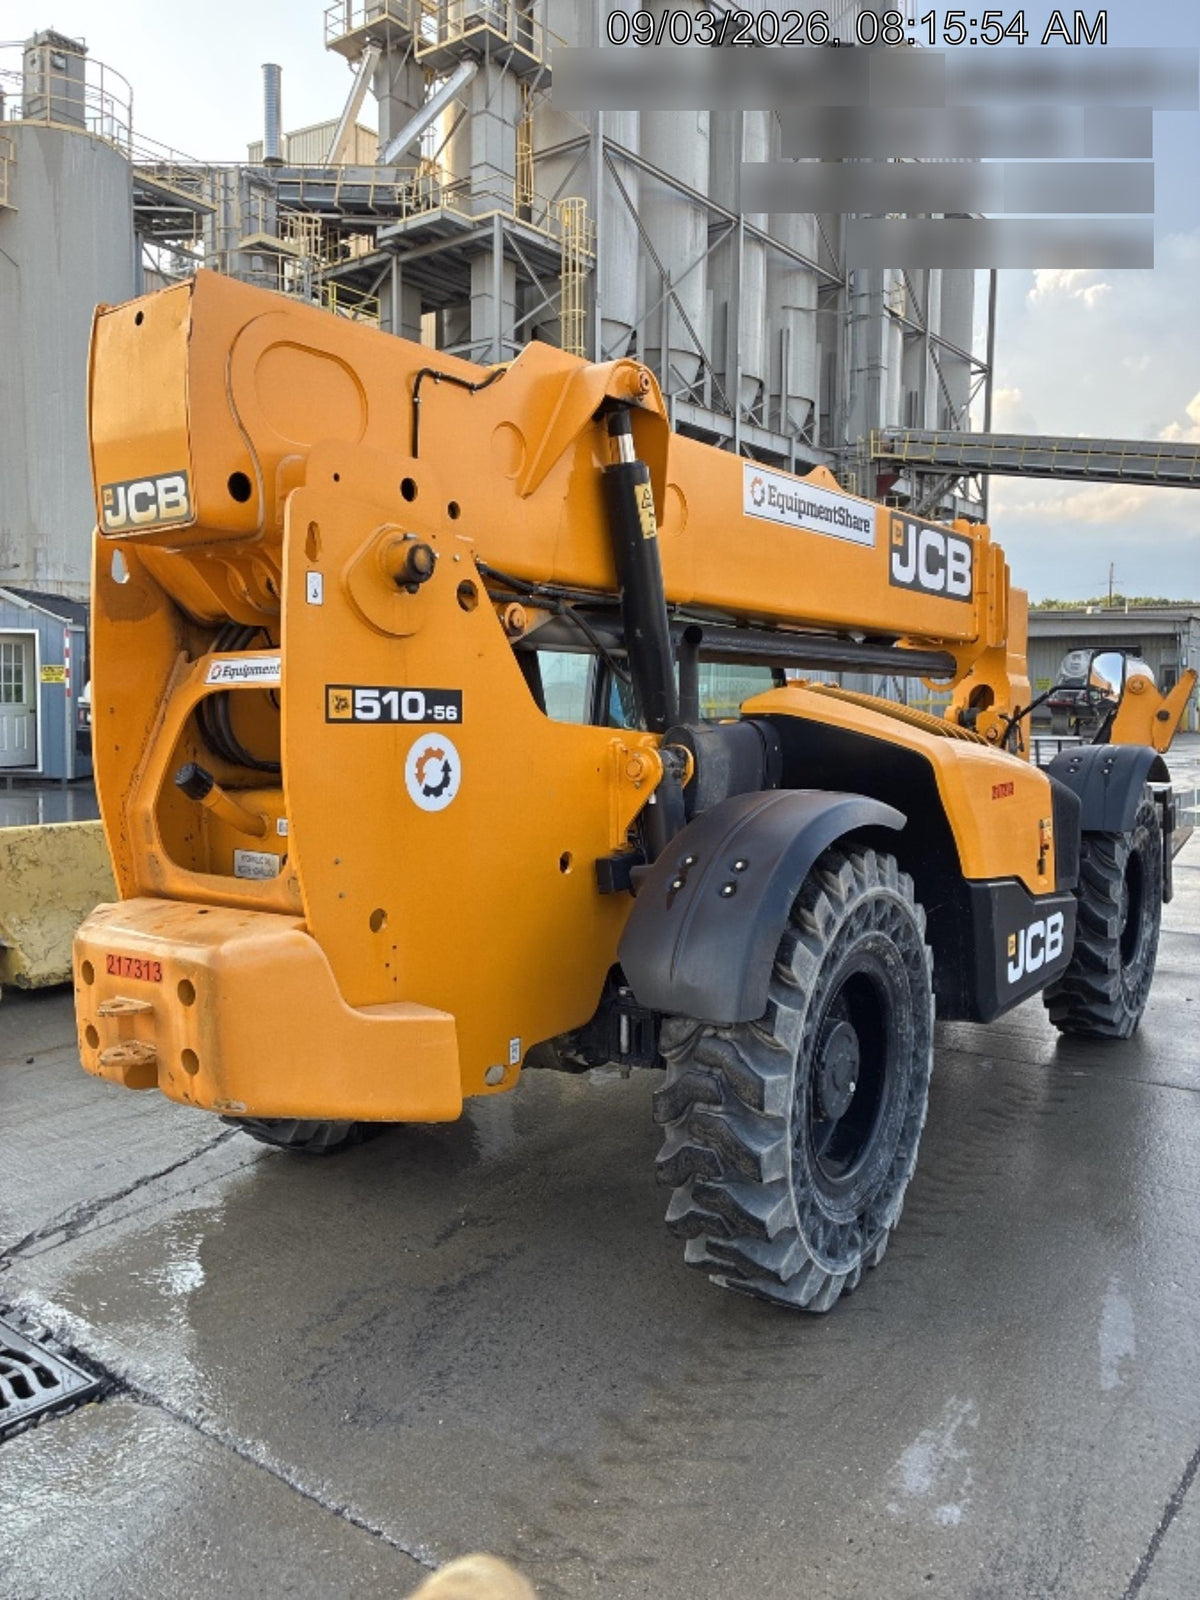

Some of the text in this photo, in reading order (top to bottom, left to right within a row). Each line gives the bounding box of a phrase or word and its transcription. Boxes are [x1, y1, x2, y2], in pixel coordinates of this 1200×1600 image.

[103, 476, 188, 527] JCB
[767, 483, 870, 533] EquipmentShare
[892, 524, 972, 596] JCB
[107, 954, 162, 982] 217313
[1007, 911, 1064, 984] JCB
